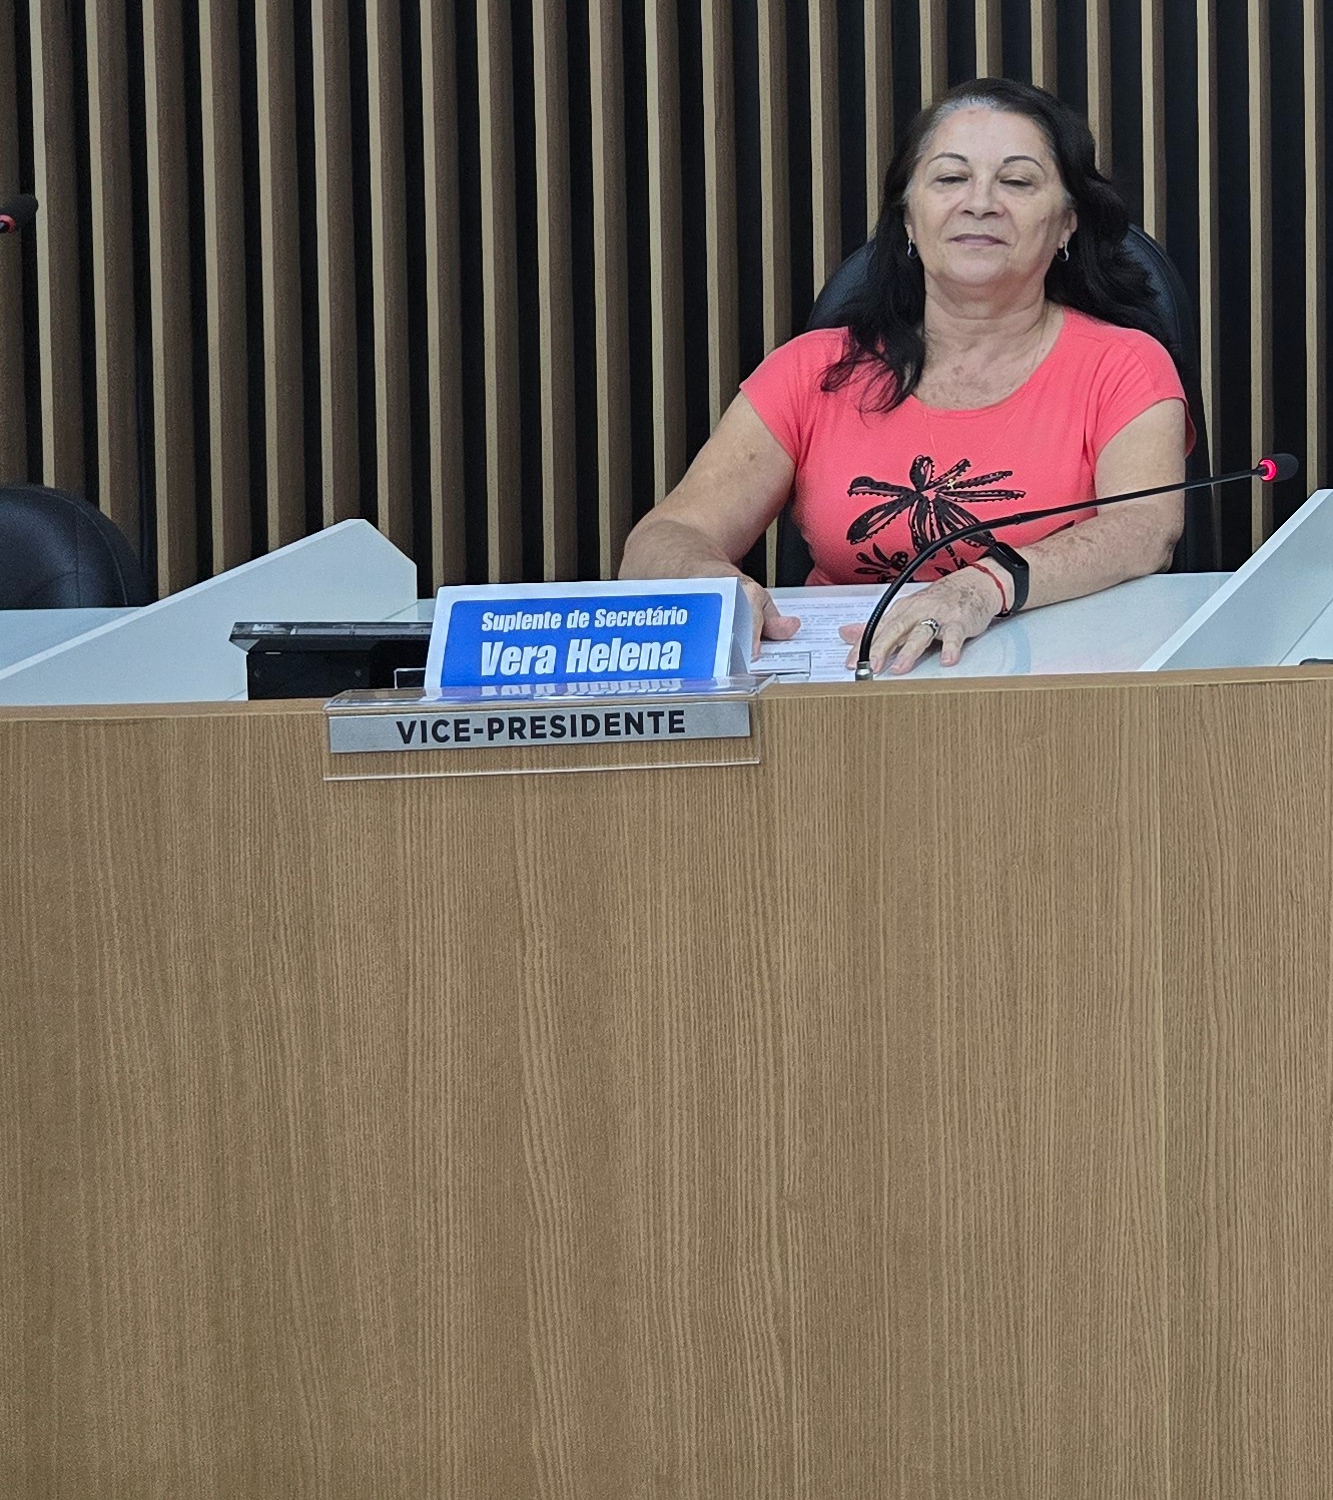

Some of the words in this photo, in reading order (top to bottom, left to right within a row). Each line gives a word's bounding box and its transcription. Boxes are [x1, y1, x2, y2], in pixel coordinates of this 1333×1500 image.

[481, 611, 563, 633] Suplente
[567, 609, 590, 627] de
[594, 605, 688, 627] Secretário
[480, 639, 556, 676] Vera
[566, 637, 682, 673] Helena
[396, 709, 686, 744] VICE-PRESIDENTE
